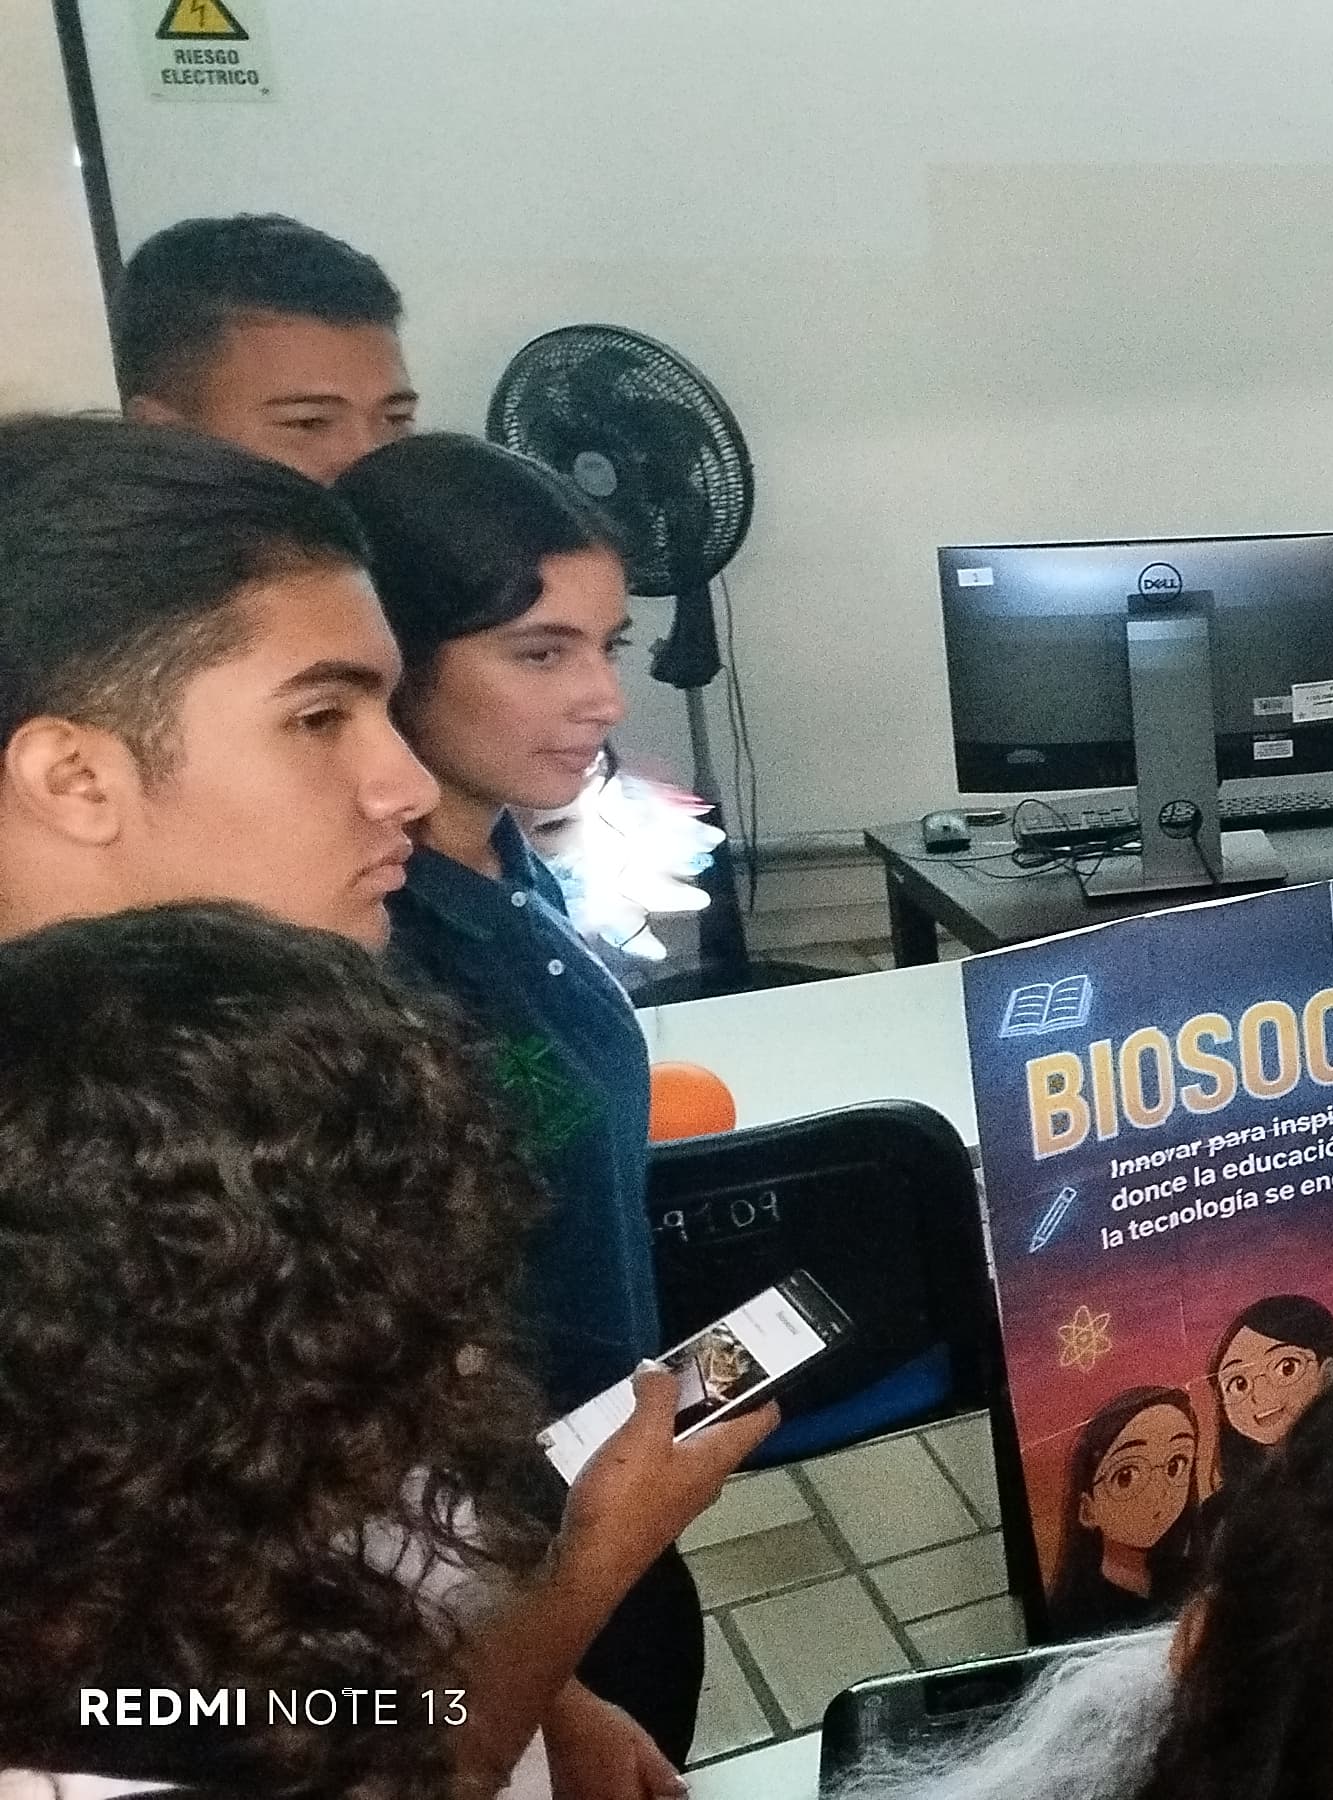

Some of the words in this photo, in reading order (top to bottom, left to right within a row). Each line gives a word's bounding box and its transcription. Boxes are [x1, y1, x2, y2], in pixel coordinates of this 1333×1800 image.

[174, 49, 239, 65] RIESGO
[161, 69, 259, 85] ELECTRICO
[1143, 579, 1178, 590] DELL
[1110, 1139, 1202, 1179] Innovar
[1208, 1125, 1266, 1157] para
[1194, 1166, 1217, 1187] la
[1101, 1227, 1124, 1250] la
[1265, 1183, 1295, 1204] se
